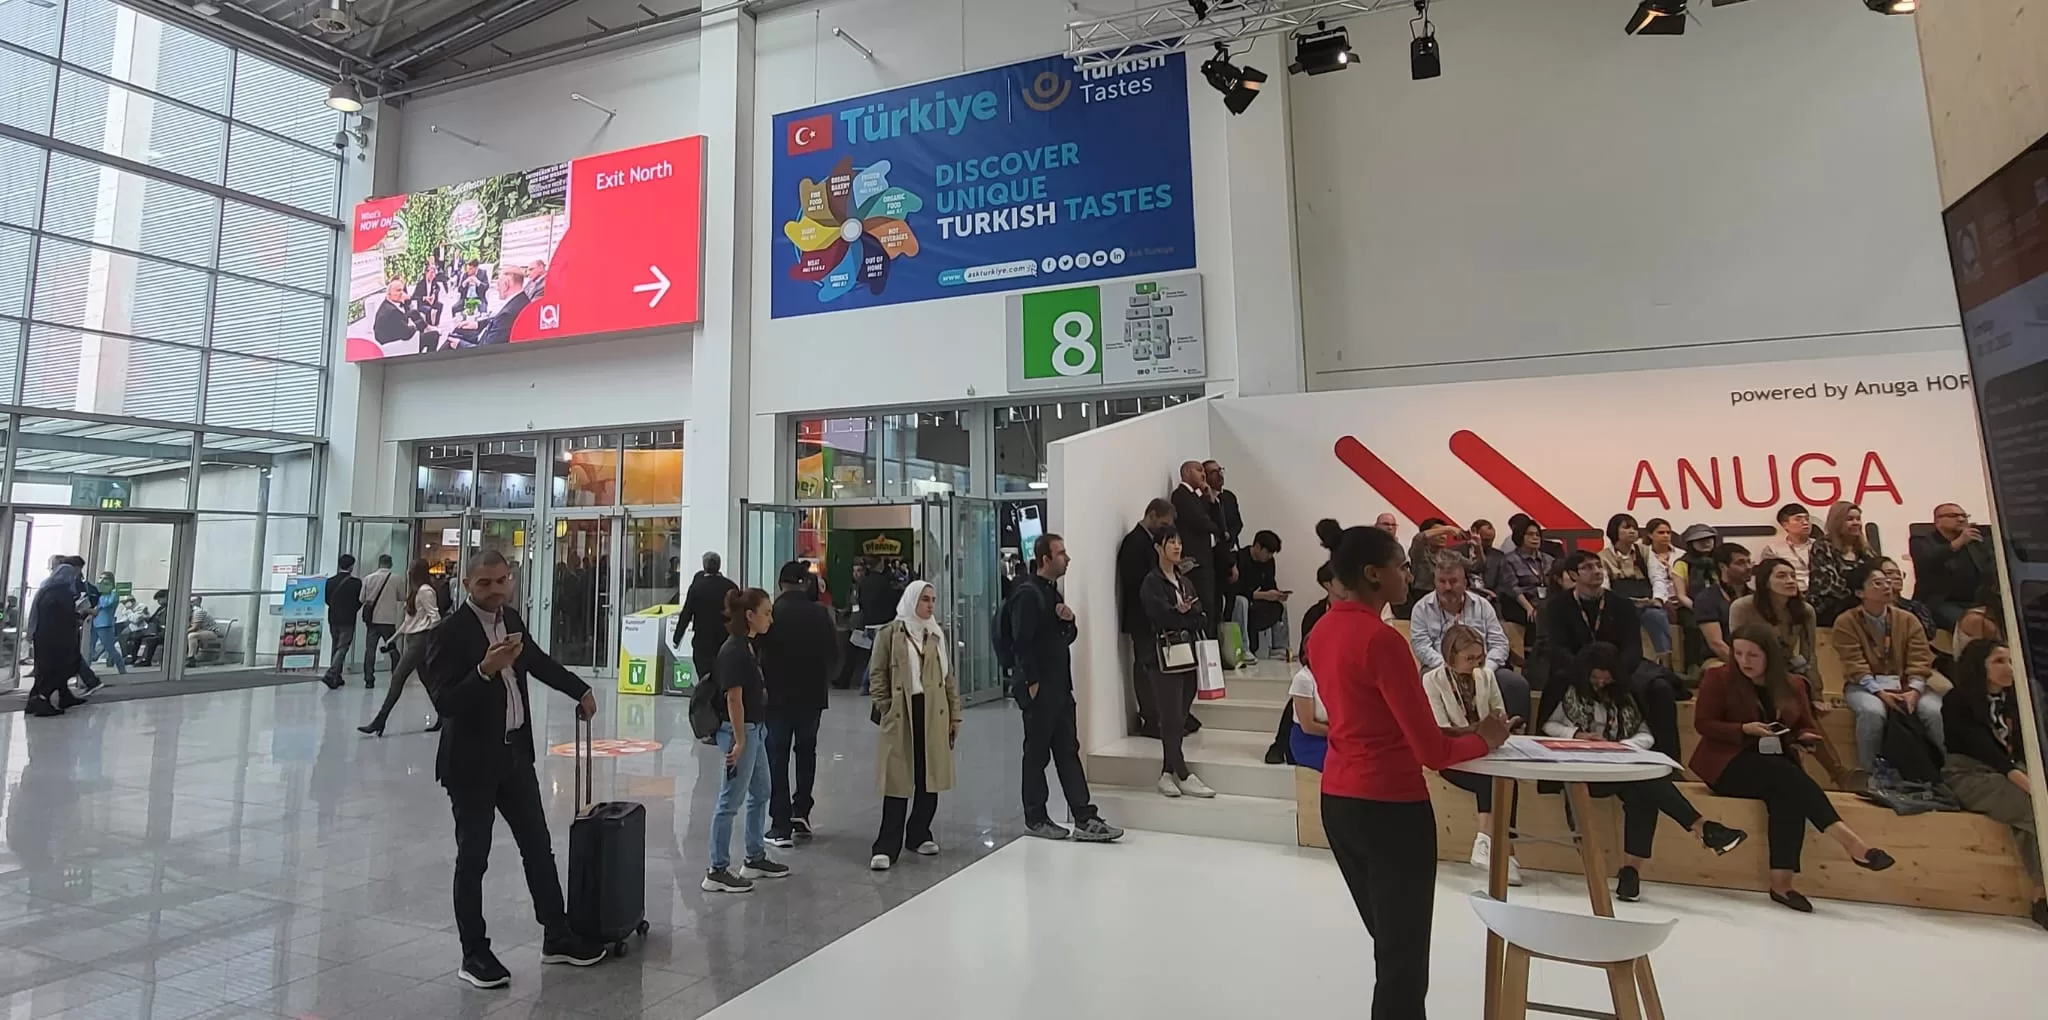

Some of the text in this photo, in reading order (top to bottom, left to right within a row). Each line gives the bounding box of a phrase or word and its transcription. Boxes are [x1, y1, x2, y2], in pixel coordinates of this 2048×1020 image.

[1079, 77, 1153, 104] Tastes
[839, 90, 998, 145] Türkiye
[596, 160, 673, 190] Exit North
[935, 142, 1080, 187] DISCOVER
[936, 175, 1048, 215] UNIQUE
[936, 184, 1173, 240] TURKISH TASTES
[359, 216, 393, 232] NOW ON
[865, 257, 875, 265] OUT
[866, 263, 882, 272] HOME
[1052, 311, 1097, 376] 8
[1730, 383, 1817, 406] powered
[1823, 382, 1849, 401] by
[1854, 380, 1919, 397] Anuga
[1625, 450, 1905, 511] ANUGA
